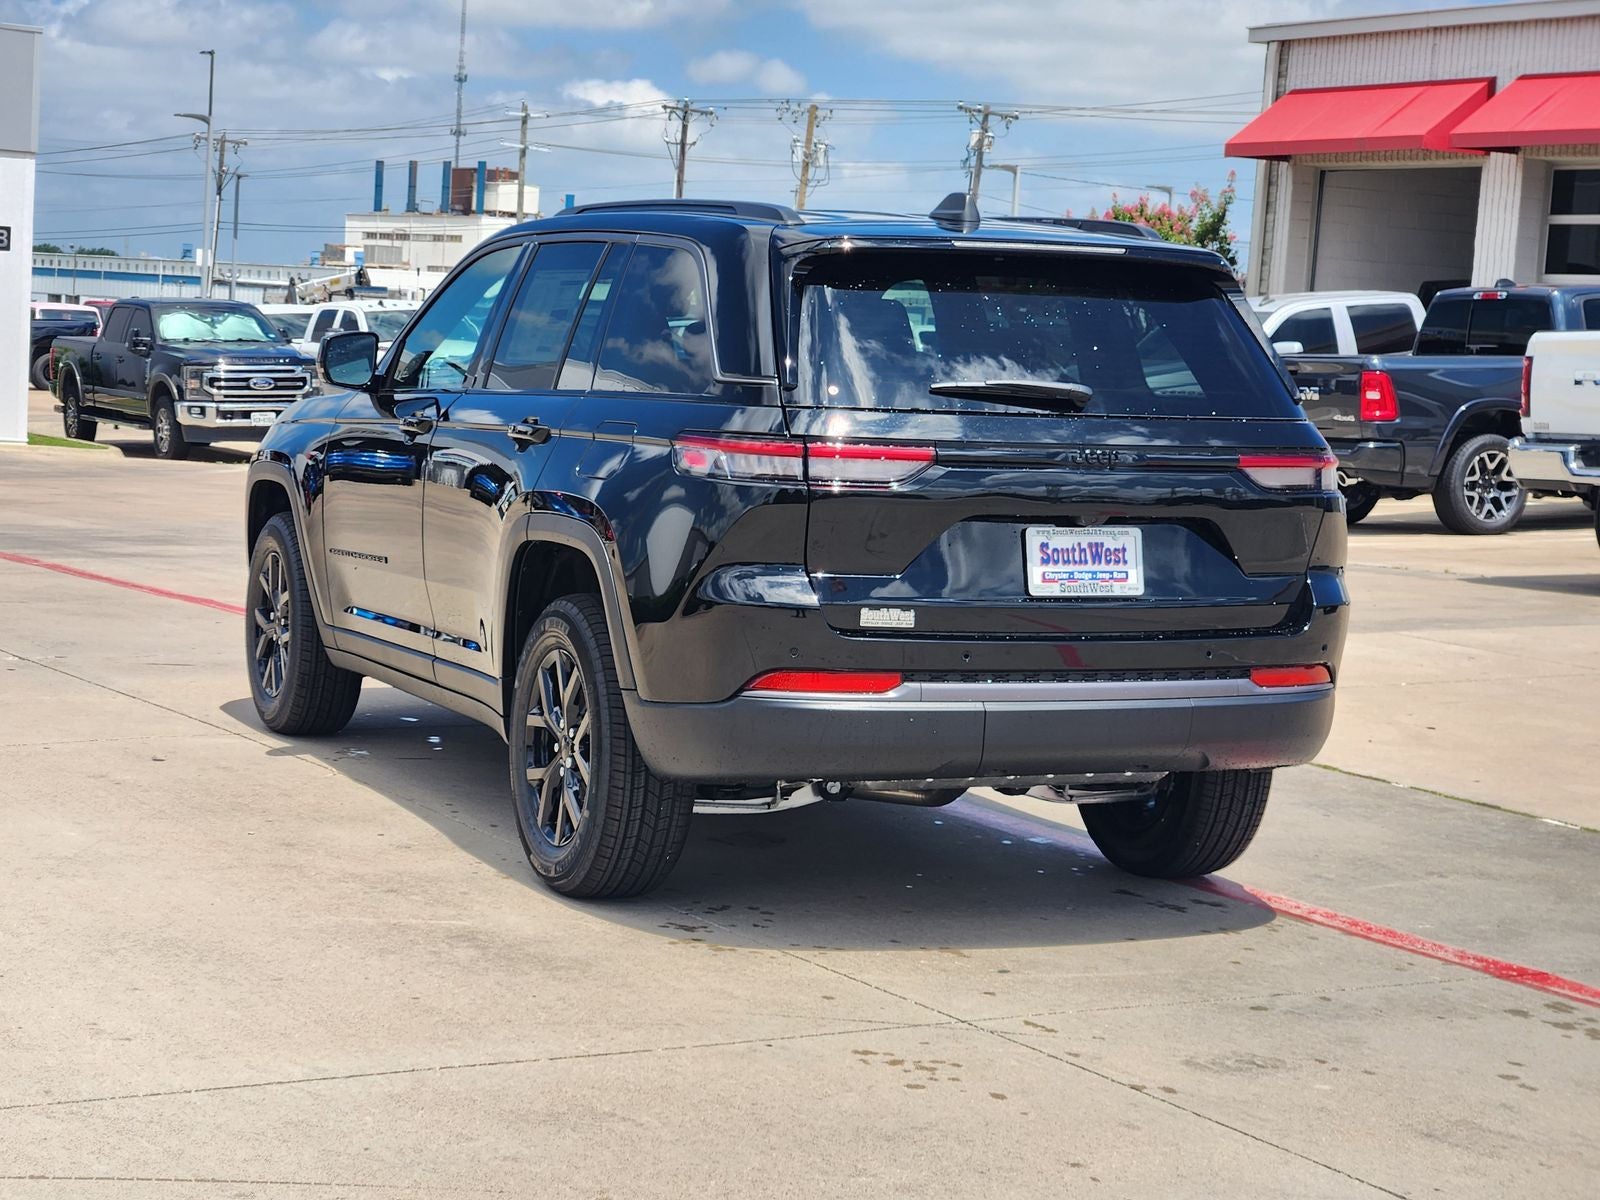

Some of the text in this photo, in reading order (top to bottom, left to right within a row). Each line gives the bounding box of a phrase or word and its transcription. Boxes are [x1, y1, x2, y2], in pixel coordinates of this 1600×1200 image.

[1039, 541, 1129, 567] SouthWest
[1073, 571, 1092, 581] Dodge
[1059, 583, 1115, 594] SouthWest
